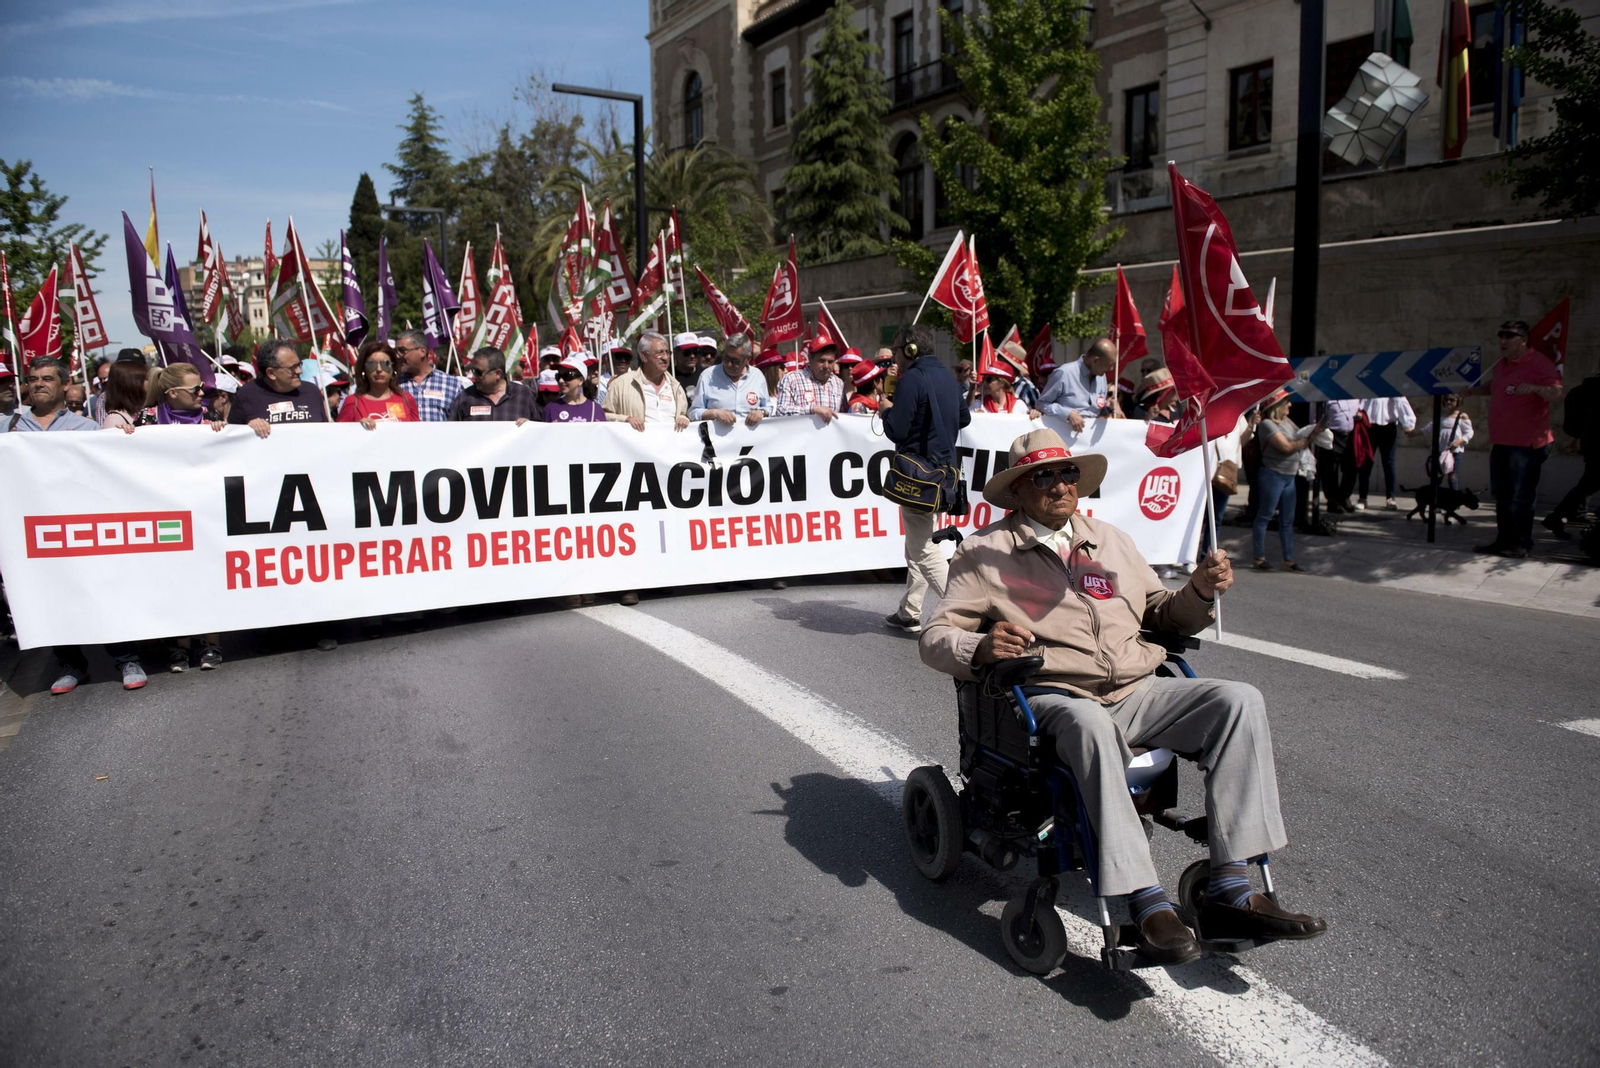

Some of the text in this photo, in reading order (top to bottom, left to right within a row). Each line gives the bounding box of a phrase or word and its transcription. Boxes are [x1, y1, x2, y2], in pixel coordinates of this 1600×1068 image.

[224, 473, 326, 537] LA
[352, 446, 807, 529] MOVILIZACIÓN
[1143, 475, 1178, 498] UGT
[35, 520, 154, 549] CCOO
[225, 535, 452, 590] RECUPERAR
[467, 523, 637, 568] DERECHOS
[688, 510, 842, 551] DEFENDER
[853, 507, 888, 539] EL
[1083, 575, 1107, 590] UGT
